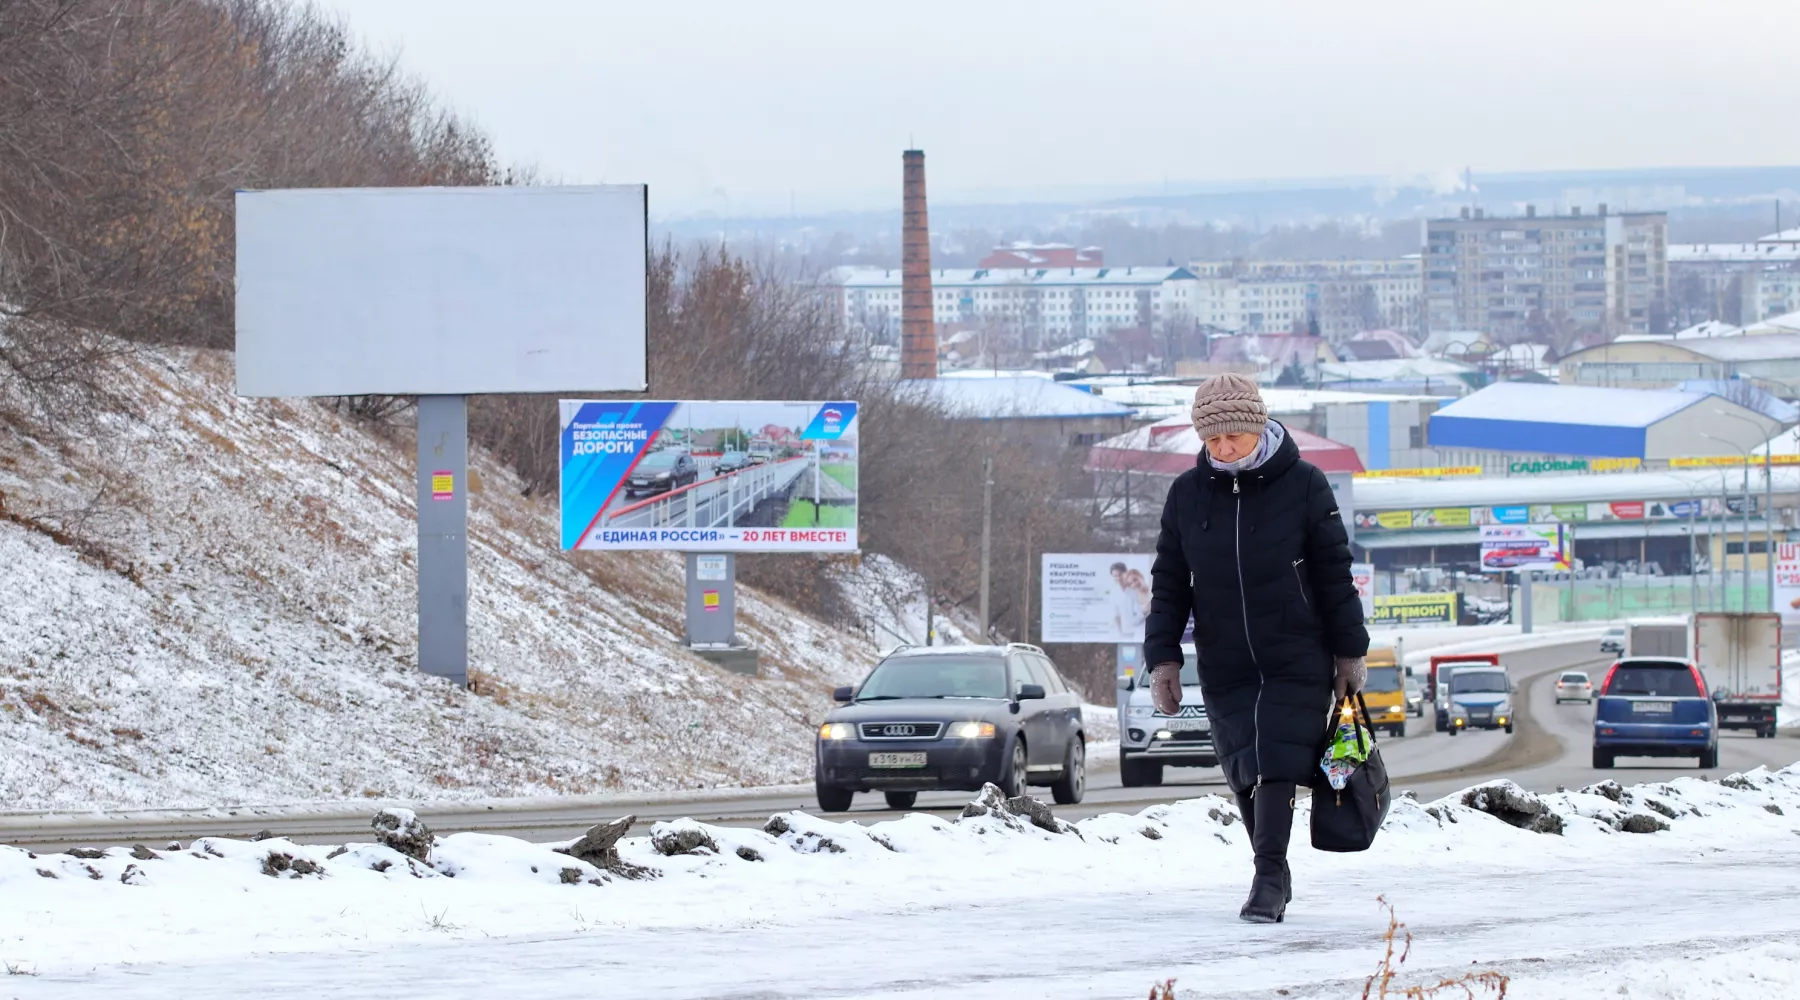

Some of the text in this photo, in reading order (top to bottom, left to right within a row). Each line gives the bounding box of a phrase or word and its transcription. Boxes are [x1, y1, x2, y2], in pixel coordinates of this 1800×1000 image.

[572, 430, 648, 441] БЕЗОПАСНЫЕ
[572, 441, 634, 456] ДОРОГИ
[1510, 457, 1641, 473] САДОВЫЙ ЦЕНТР
[595, 531, 657, 543] «ЕДИНАЯ
[661, 531, 725, 542] РОССИЯ»
[743, 531, 759, 541] 20
[762, 531, 786, 542] ЛЕТ
[790, 531, 847, 542] ВМЕСТЕ!
[1392, 604, 1446, 618] РЕМОНТ
